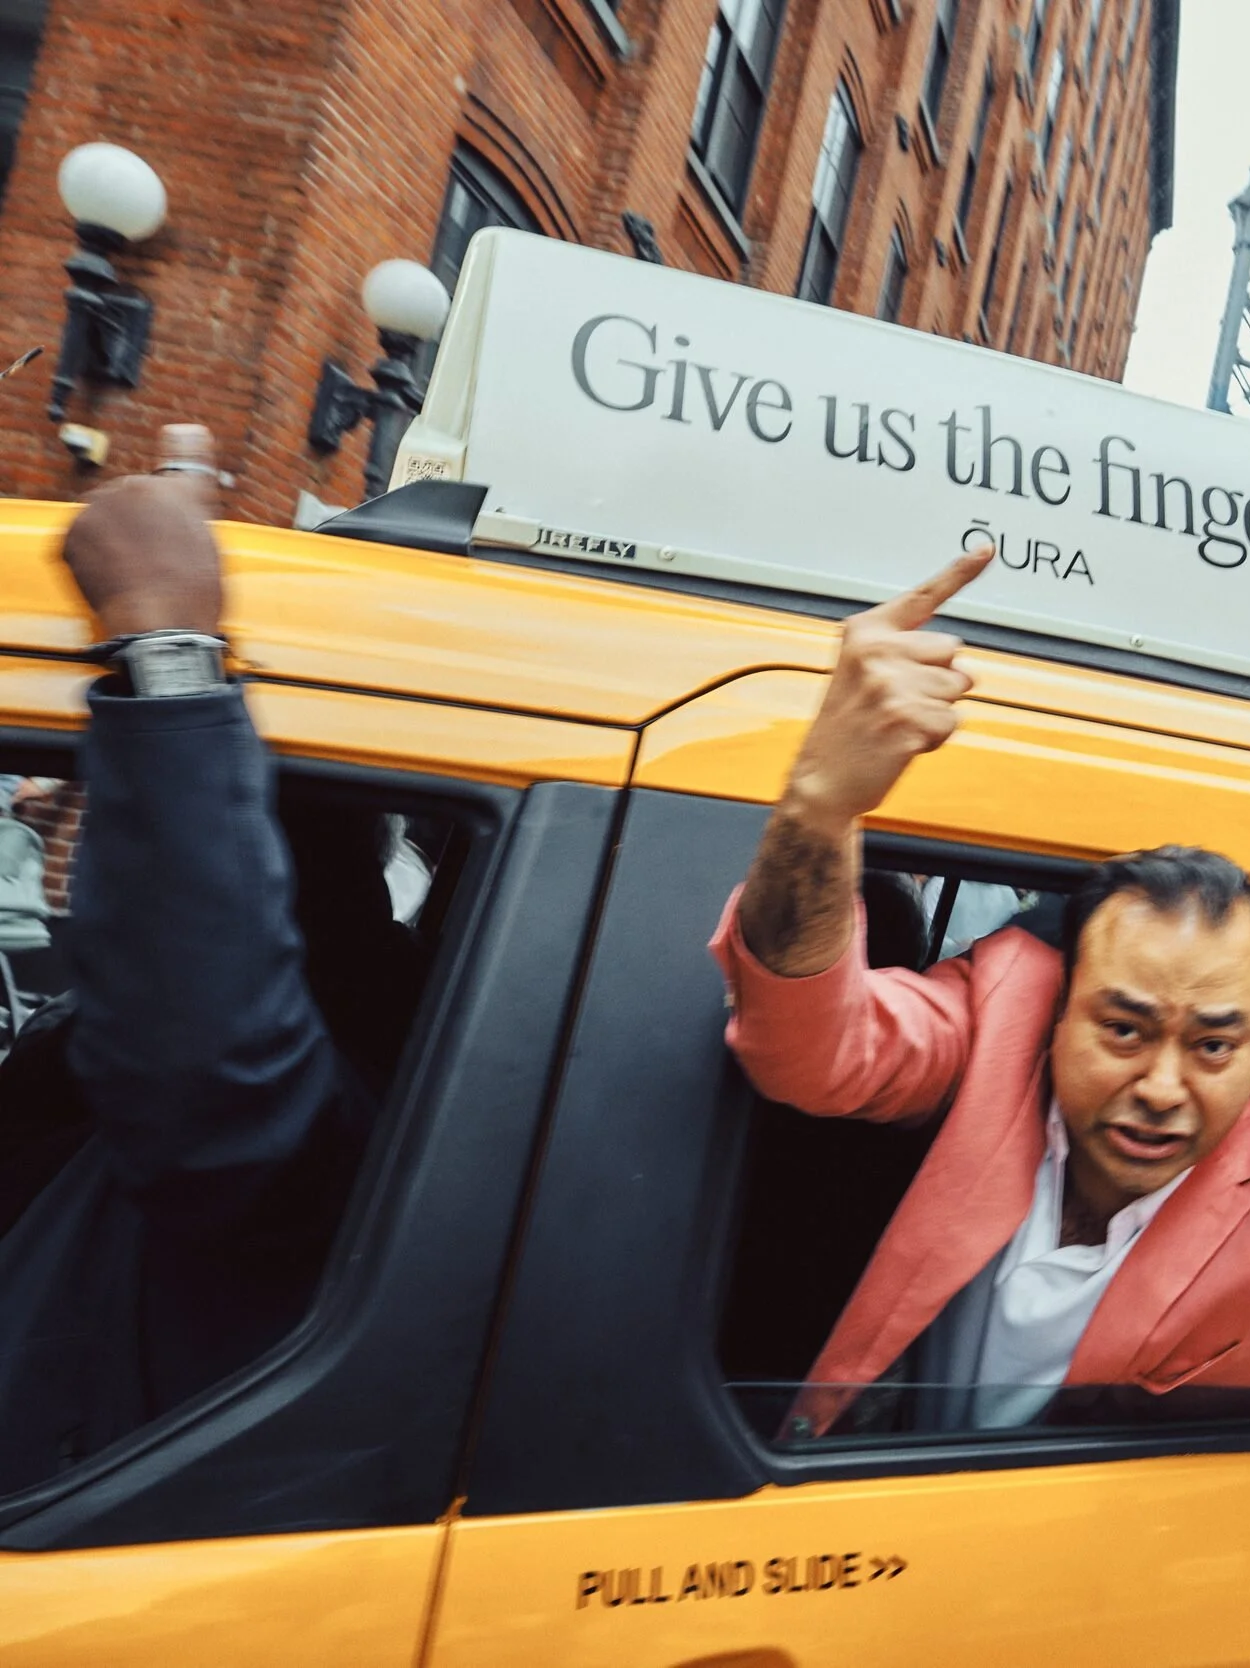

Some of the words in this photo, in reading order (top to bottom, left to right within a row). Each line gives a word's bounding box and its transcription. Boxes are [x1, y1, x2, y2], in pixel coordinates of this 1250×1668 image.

[570, 313, 793, 444] Give
[818, 395, 916, 472] us
[938, 404, 1072, 507] the
[540, 528, 637, 559] IREFLY
[575, 1566, 673, 1611] PULL
[677, 1560, 756, 1602] AND
[763, 1552, 862, 1595] SLIDE
